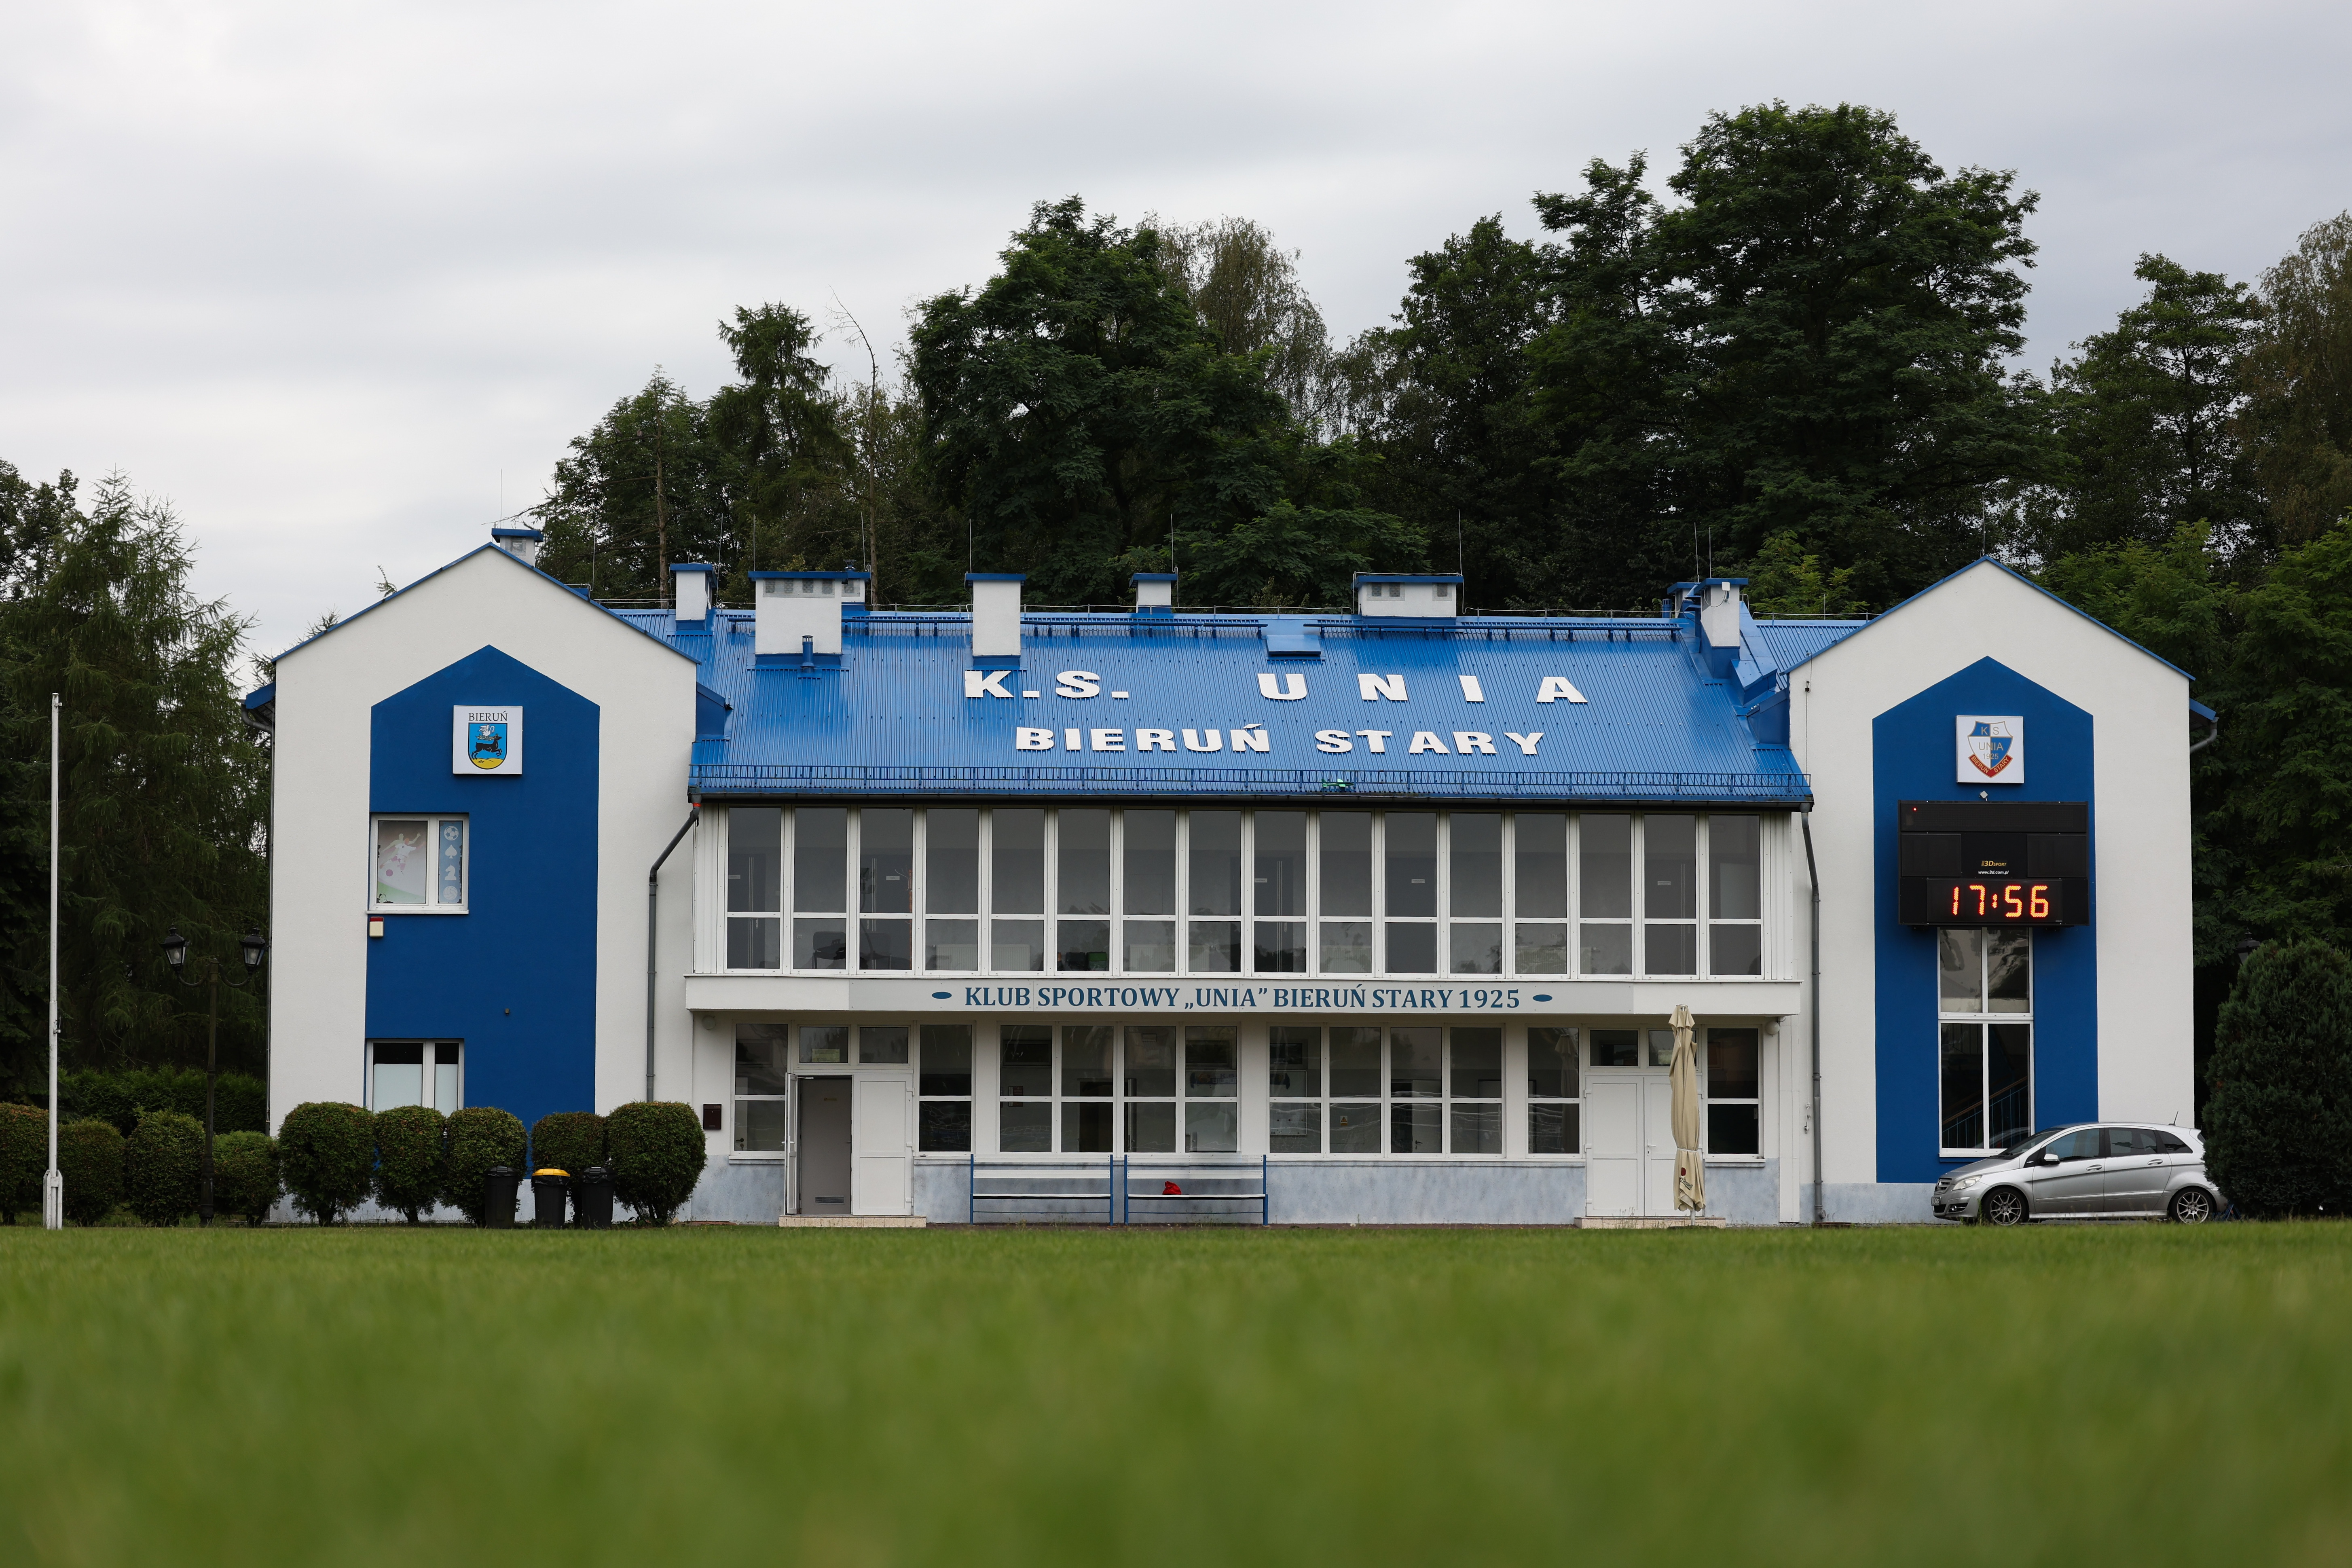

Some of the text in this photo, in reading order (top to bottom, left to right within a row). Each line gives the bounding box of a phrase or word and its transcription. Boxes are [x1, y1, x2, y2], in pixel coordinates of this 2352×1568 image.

[964, 671, 1588, 703] K.S. UNIA
[468, 711, 508, 722] BIERUŃ
[1016, 723, 1544, 755] BIERUŃ STARY
[1978, 742, 2004, 751] UNIA
[1993, 757, 2009, 773] STARY
[1952, 885, 2049, 918] 17:56
[965, 987, 1030, 1006] KLUB
[1038, 988, 1180, 1007] SPORTOWY
[1273, 984, 1366, 1008] BIERUŃ
[1372, 989, 1453, 1008] STARY
[1459, 989, 1519, 1008] 1925
